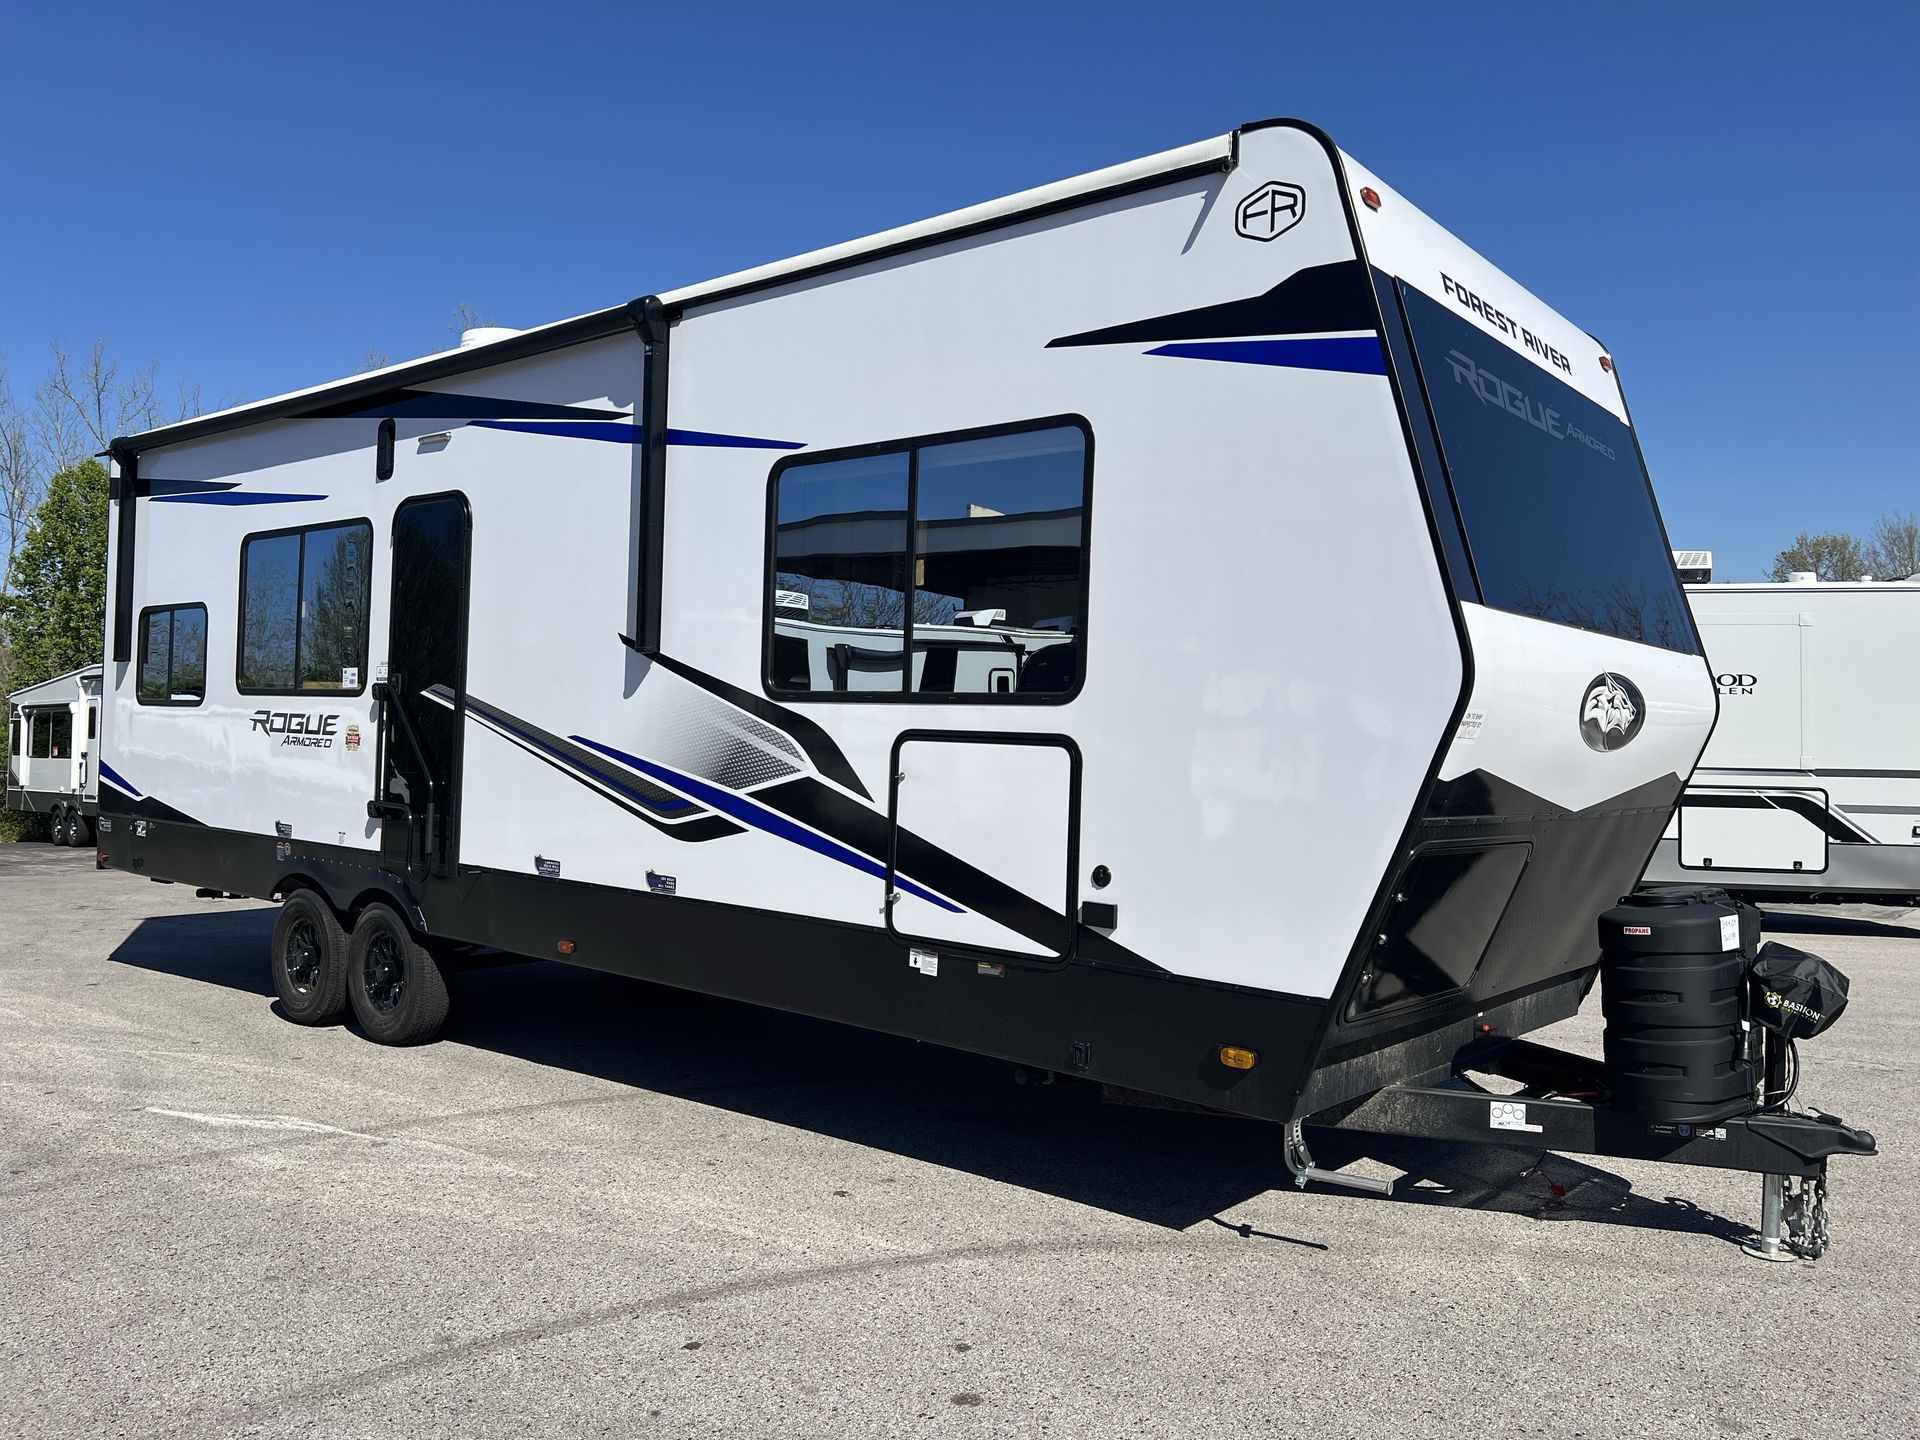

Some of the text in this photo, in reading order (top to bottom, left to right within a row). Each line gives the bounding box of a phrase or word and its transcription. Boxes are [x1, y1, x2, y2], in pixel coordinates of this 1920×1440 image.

[1241, 188, 1299, 234] FR
[1440, 271, 1573, 377] FOREST RIVER
[1444, 349, 1616, 462] ROGUE ARMORED
[1713, 673, 1758, 687] OD
[249, 709, 341, 748] ROGUE ARMORED
[1624, 927, 1650, 935] PROPANE
[1782, 999, 1821, 1021] BASTION
